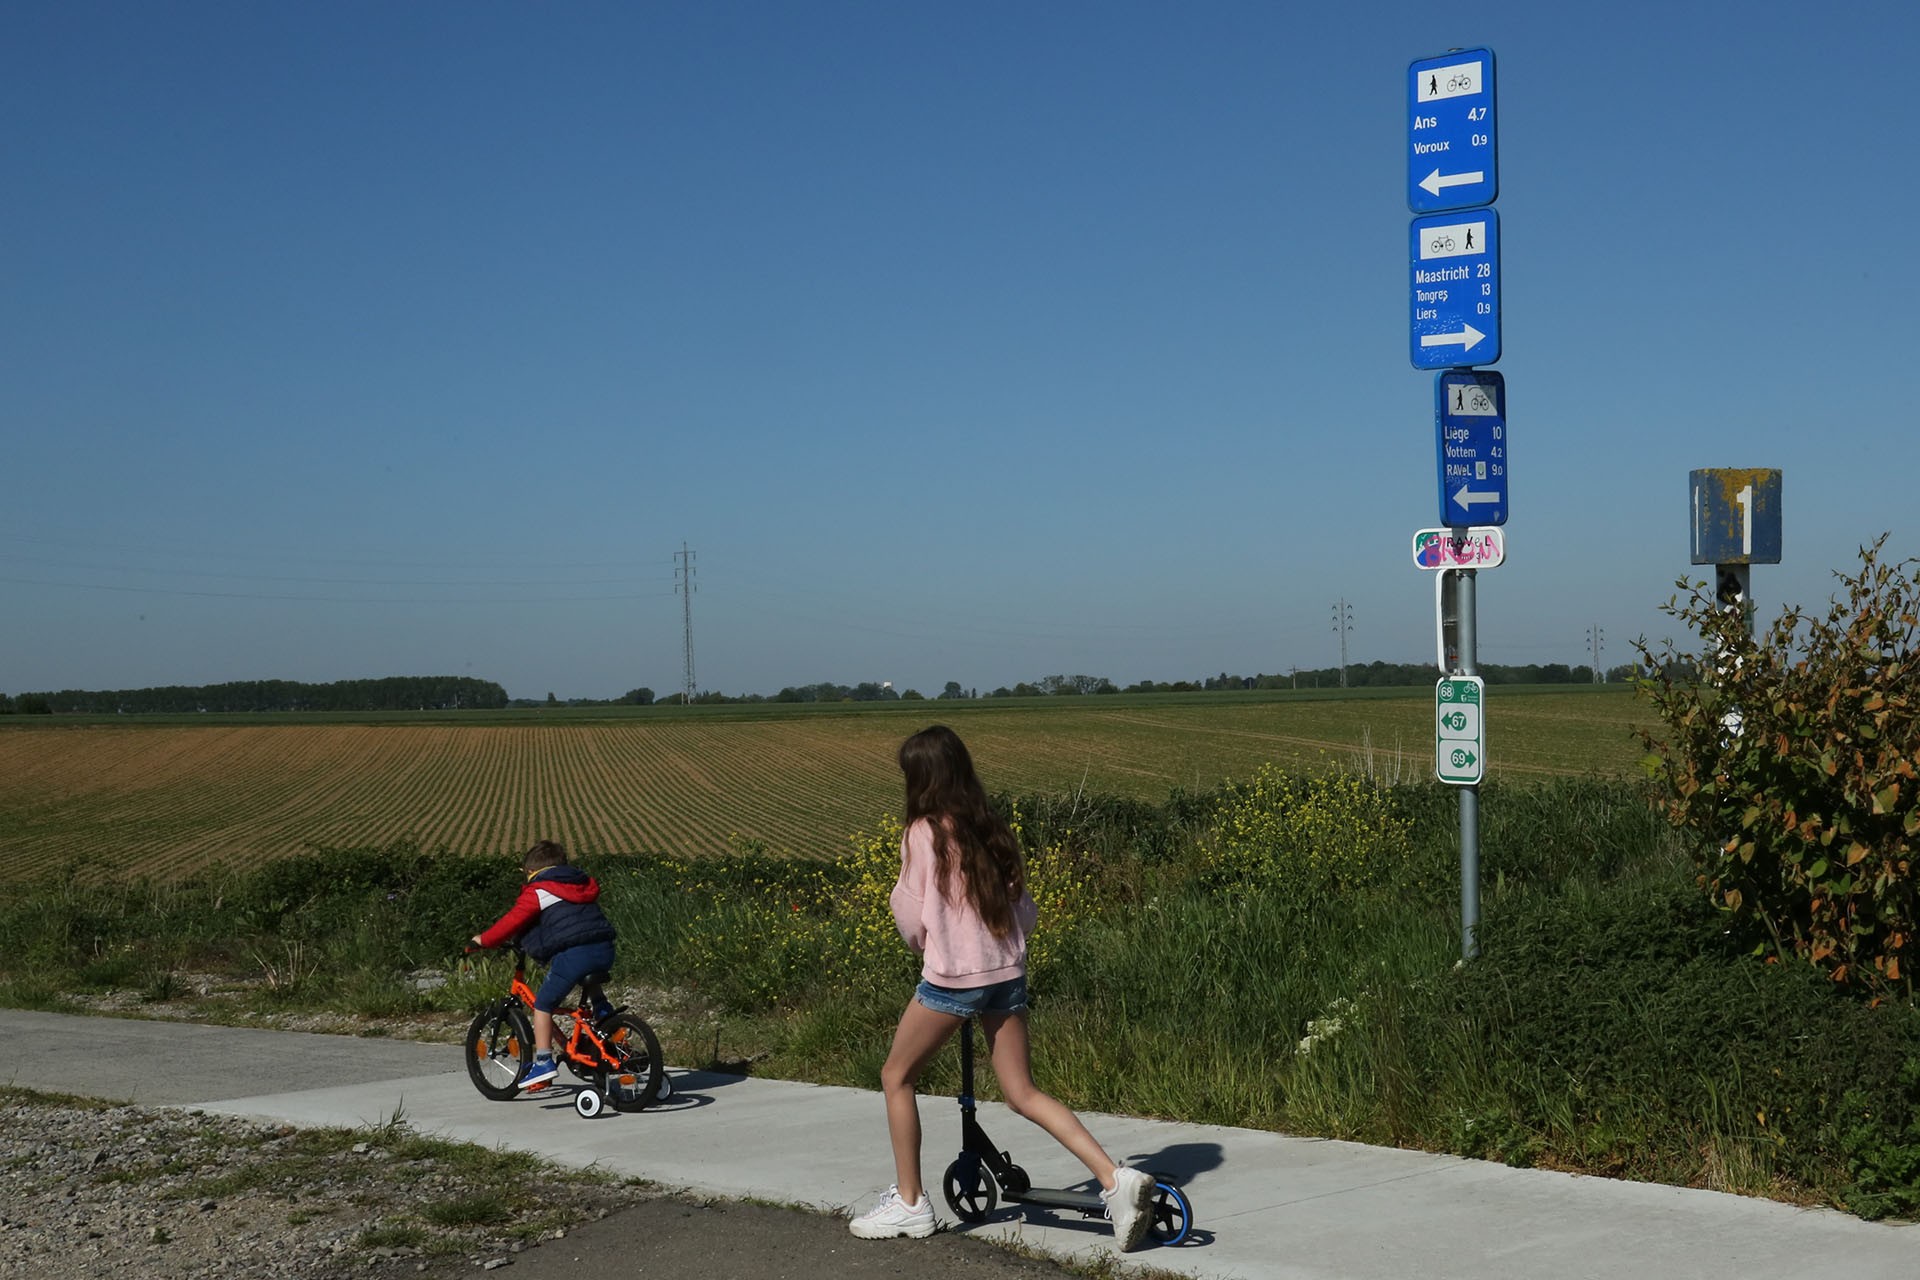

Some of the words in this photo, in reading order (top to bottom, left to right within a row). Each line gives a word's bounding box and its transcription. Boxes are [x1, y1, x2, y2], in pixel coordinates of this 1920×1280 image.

[1414, 116, 1437, 130] Ans
[1467, 107, 1487, 121] 4.7
[1414, 141, 1450, 154] Voroux
[1471, 134, 1488, 146] 0.9
[1416, 266, 1470, 284] Maastricht
[1477, 263, 1491, 278] 28
[1416, 289, 1448, 304] Tongres
[1481, 283, 1491, 296] 13
[1416, 308, 1437, 320] Liers
[1477, 302, 1491, 315] 0.9
[1492, 426, 1502, 440] 10
[1445, 446, 1476, 458] Vottem
[1446, 464, 1472, 476] RAVeL
[1736, 485, 1752, 555] 1
[1441, 687, 1453, 697] 68
[1452, 715, 1465, 727] 67
[1452, 752, 1466, 765] 69
